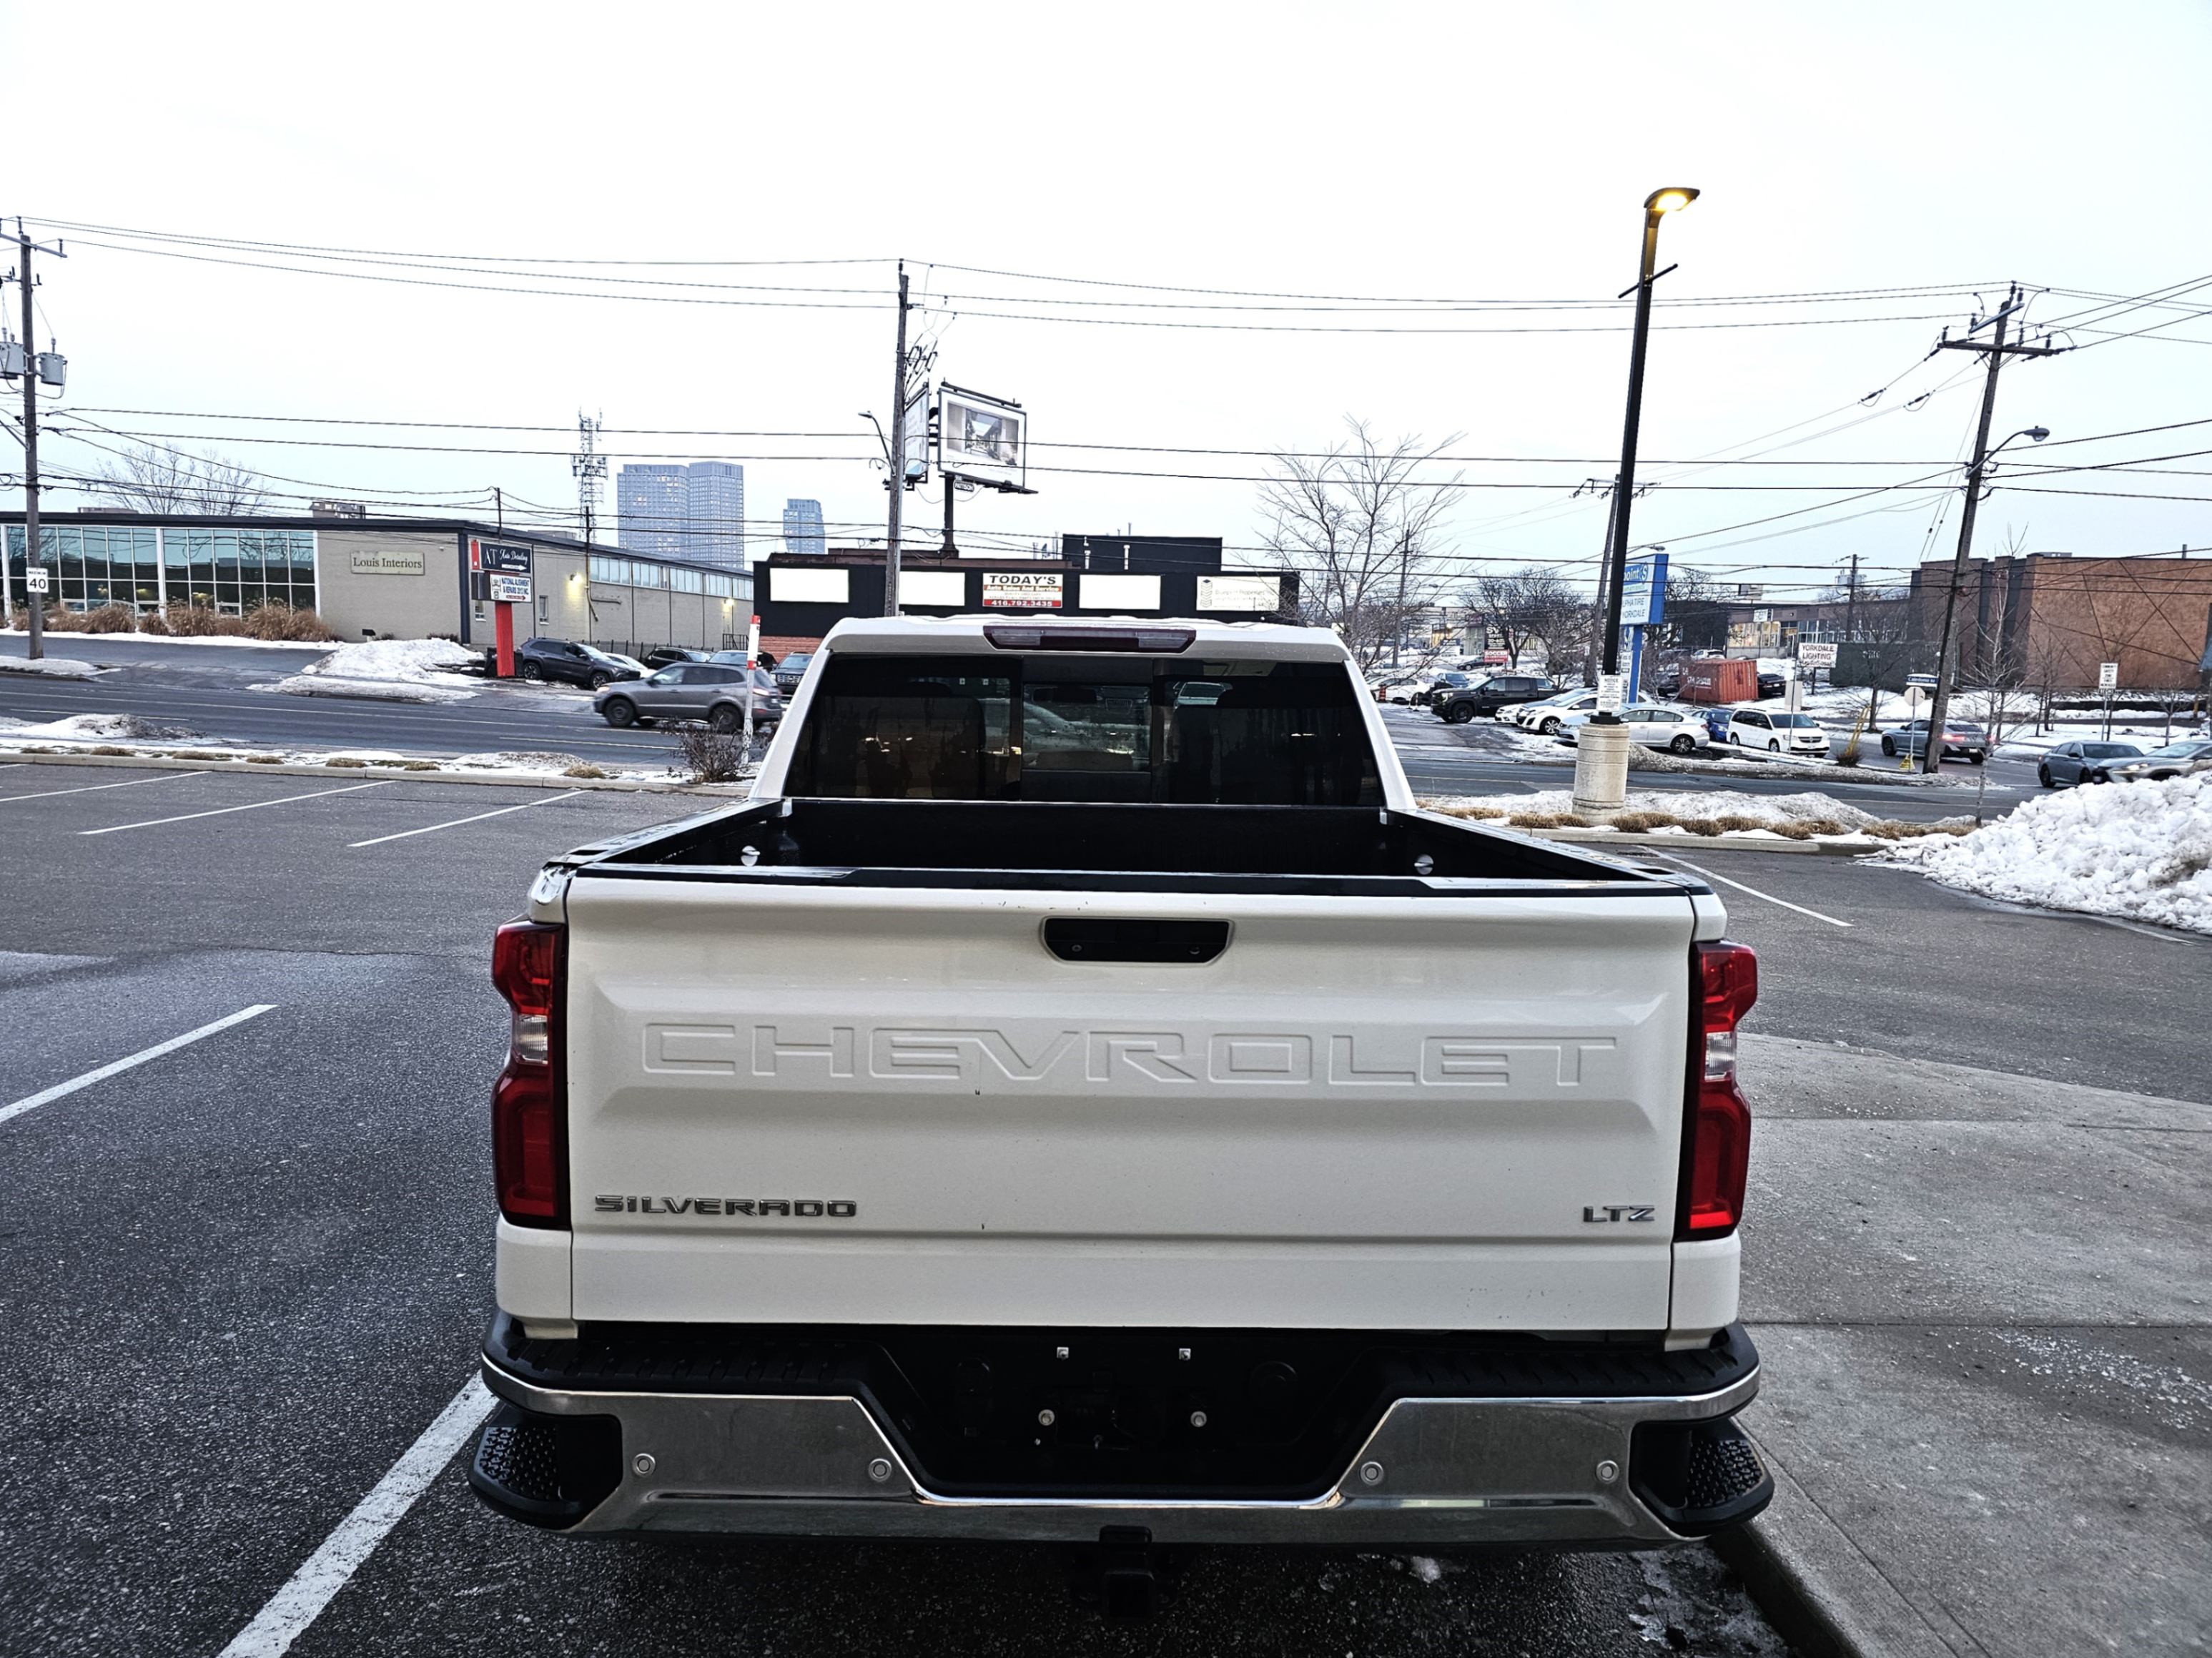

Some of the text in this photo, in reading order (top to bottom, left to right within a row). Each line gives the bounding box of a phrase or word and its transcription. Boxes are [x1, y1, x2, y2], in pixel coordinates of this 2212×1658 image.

[353, 557, 423, 568] Louis Interiors
[484, 548, 498, 565] AT
[29, 578, 46, 590] 40
[989, 575, 1057, 586] TODAY'S
[643, 1023, 1616, 1087] CHEVROLET
[595, 1195, 857, 1217] SILVERADO
[1583, 1205, 1655, 1222] LTZ
